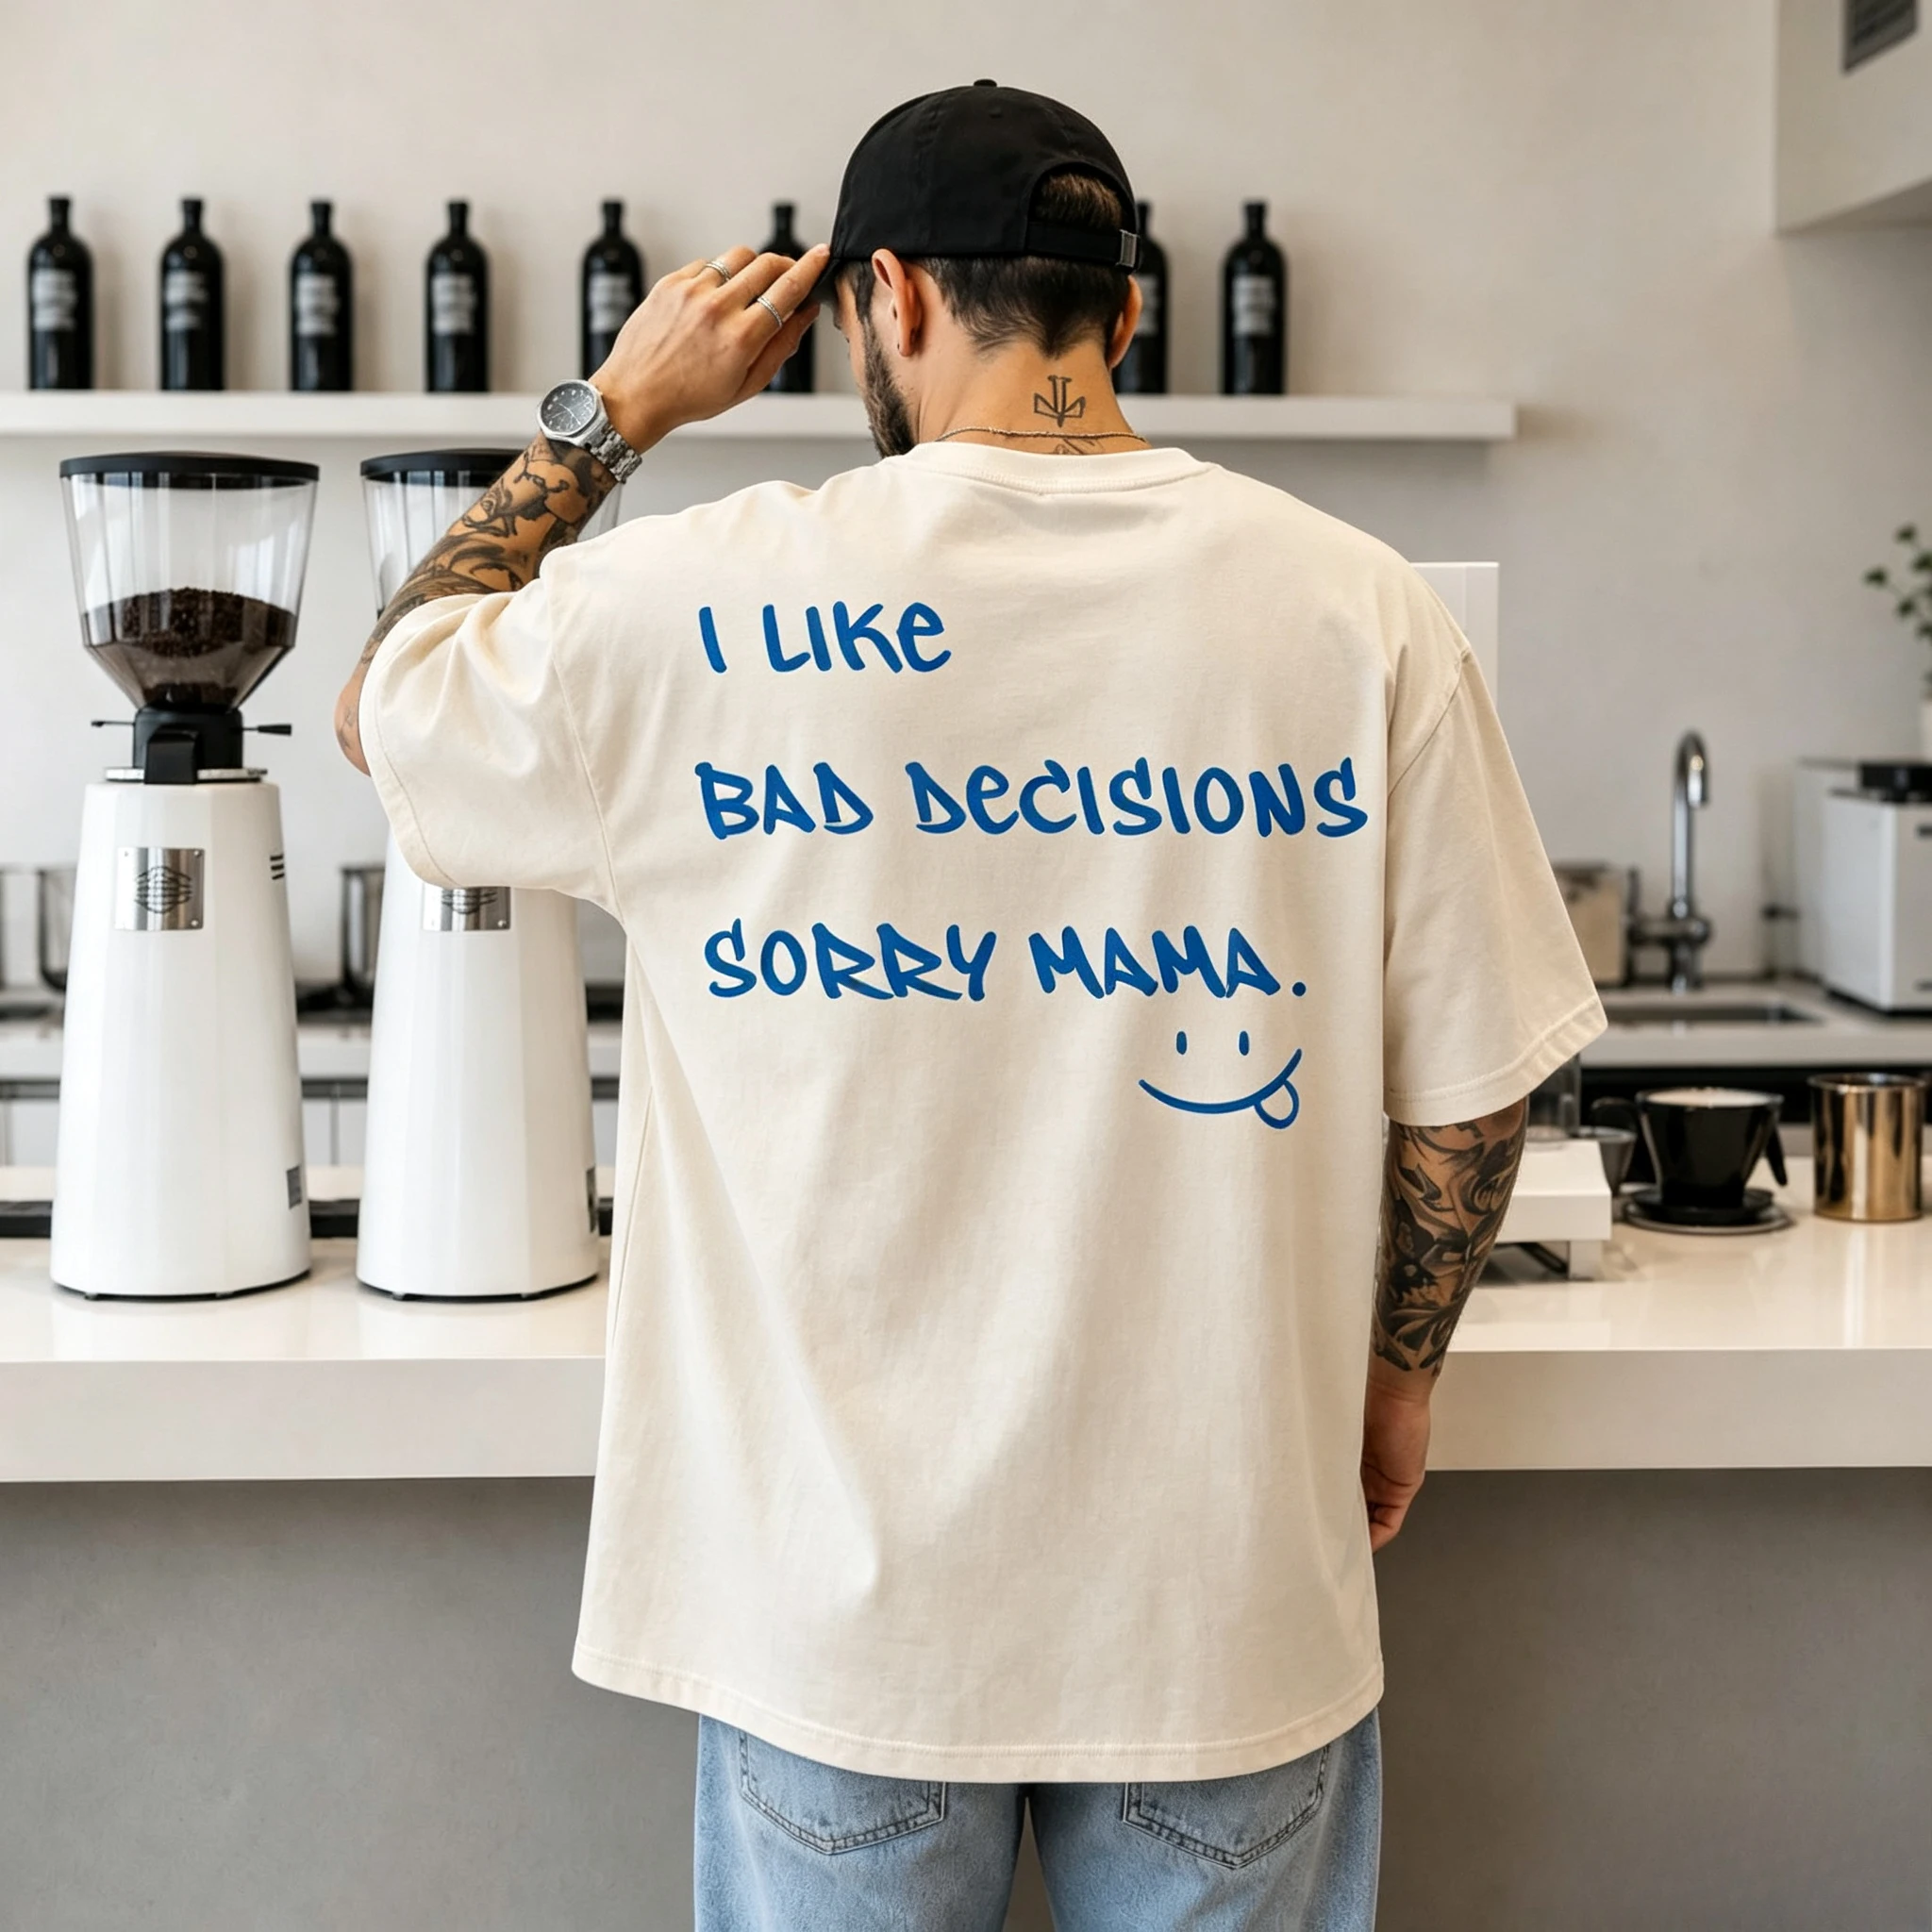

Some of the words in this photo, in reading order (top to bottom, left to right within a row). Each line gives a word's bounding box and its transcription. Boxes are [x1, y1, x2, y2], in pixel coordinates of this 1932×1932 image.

[698, 605, 727, 675] I
[694, 760, 874, 841] BAD
[703, 917, 997, 1002] SORRY
[1027, 924, 1307, 1001] MAMA.
